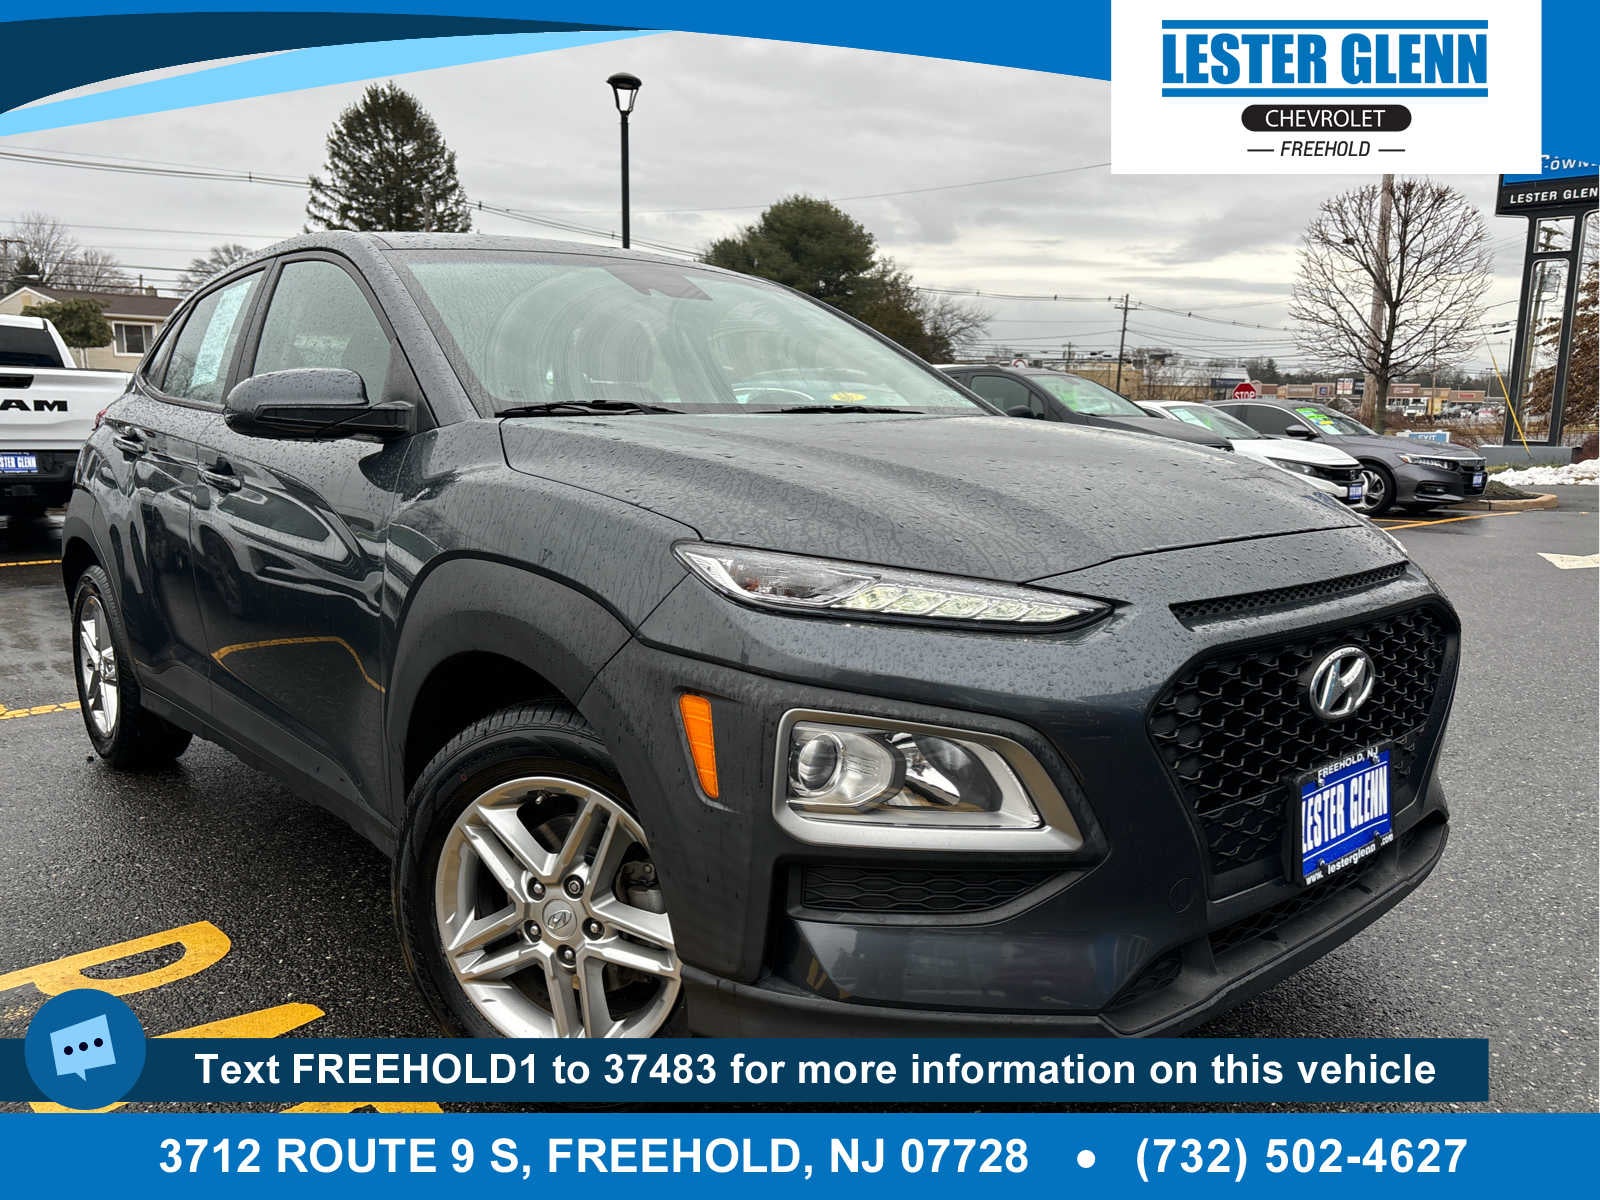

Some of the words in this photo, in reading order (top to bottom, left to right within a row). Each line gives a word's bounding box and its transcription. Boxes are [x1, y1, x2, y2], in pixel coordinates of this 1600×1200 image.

[1510, 190, 1557, 204] LESTER
[1563, 187, 1598, 200] GLEN
[1234, 391, 1255, 400] STOP
[0, 399, 68, 411] AM
[0, 456, 16, 468] STER
[1301, 783, 1346, 853] LESTER
[1350, 765, 1388, 829] GLENN
[1327, 843, 1376, 874] lesterglenn
